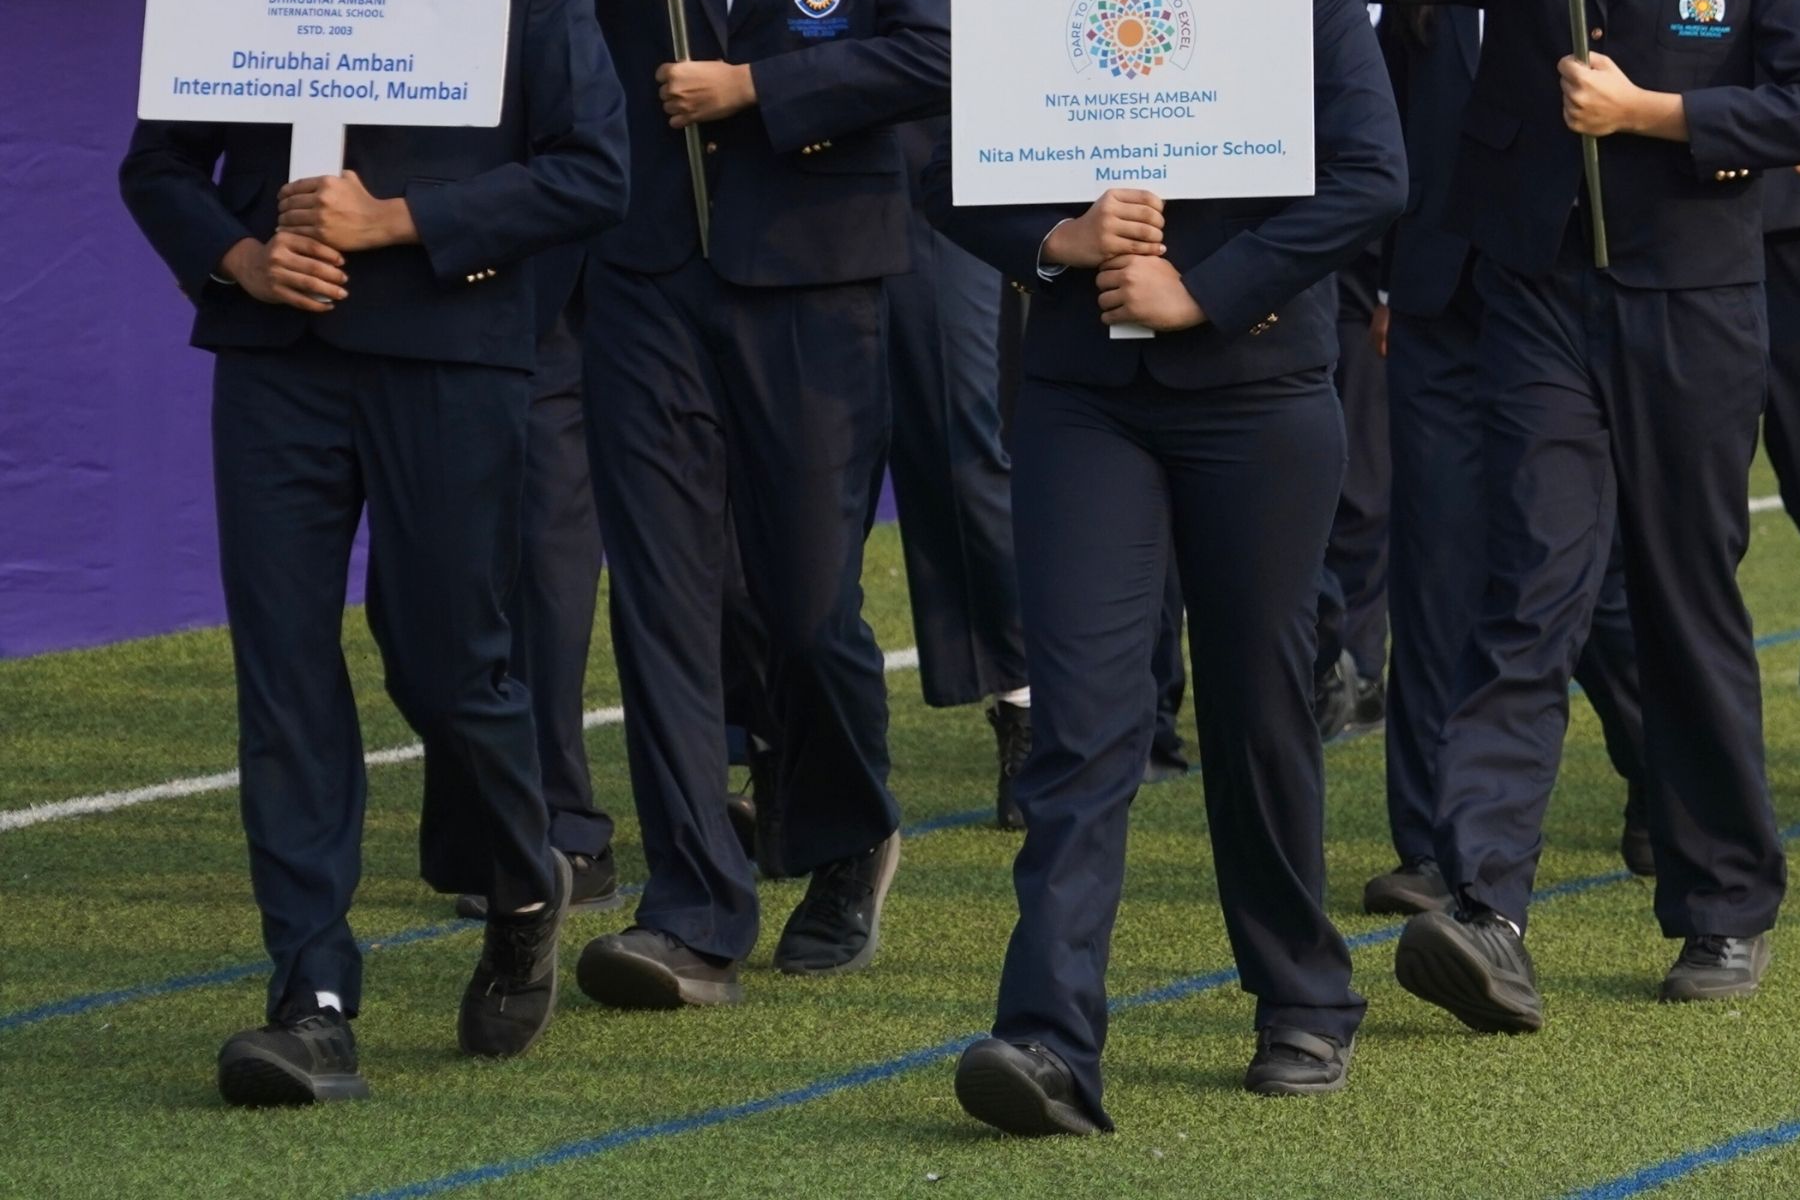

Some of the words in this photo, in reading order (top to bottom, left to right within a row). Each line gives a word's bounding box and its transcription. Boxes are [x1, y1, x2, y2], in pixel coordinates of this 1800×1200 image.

[267, 7, 343, 18] INTERNATIONAL
[345, 8, 385, 19] SCHOOL
[1075, 1, 1088, 17] TO
[296, 24, 325, 35] ESTD.
[328, 25, 353, 36] 2003
[1178, 11, 1191, 50] EXCEL
[1071, 21, 1083, 58] DARE
[232, 50, 330, 71] Dhirubhai
[336, 52, 414, 73] Ambani
[173, 76, 303, 98] International
[309, 79, 379, 101] School,
[386, 81, 468, 101] Mumbai
[1045, 93, 1081, 108] NITA
[1084, 92, 1150, 106] MUKESH
[1153, 90, 1217, 104] AMBANI
[1067, 107, 1126, 122] JUNIOR
[1129, 105, 1195, 120] SCHOOL
[979, 147, 1014, 163] Nita
[1019, 145, 1086, 162] Mukesh
[1089, 142, 1159, 160] Ambani
[1162, 141, 1219, 158] Junior
[1222, 139, 1286, 156] School,
[1095, 164, 1167, 181] Mumbai
